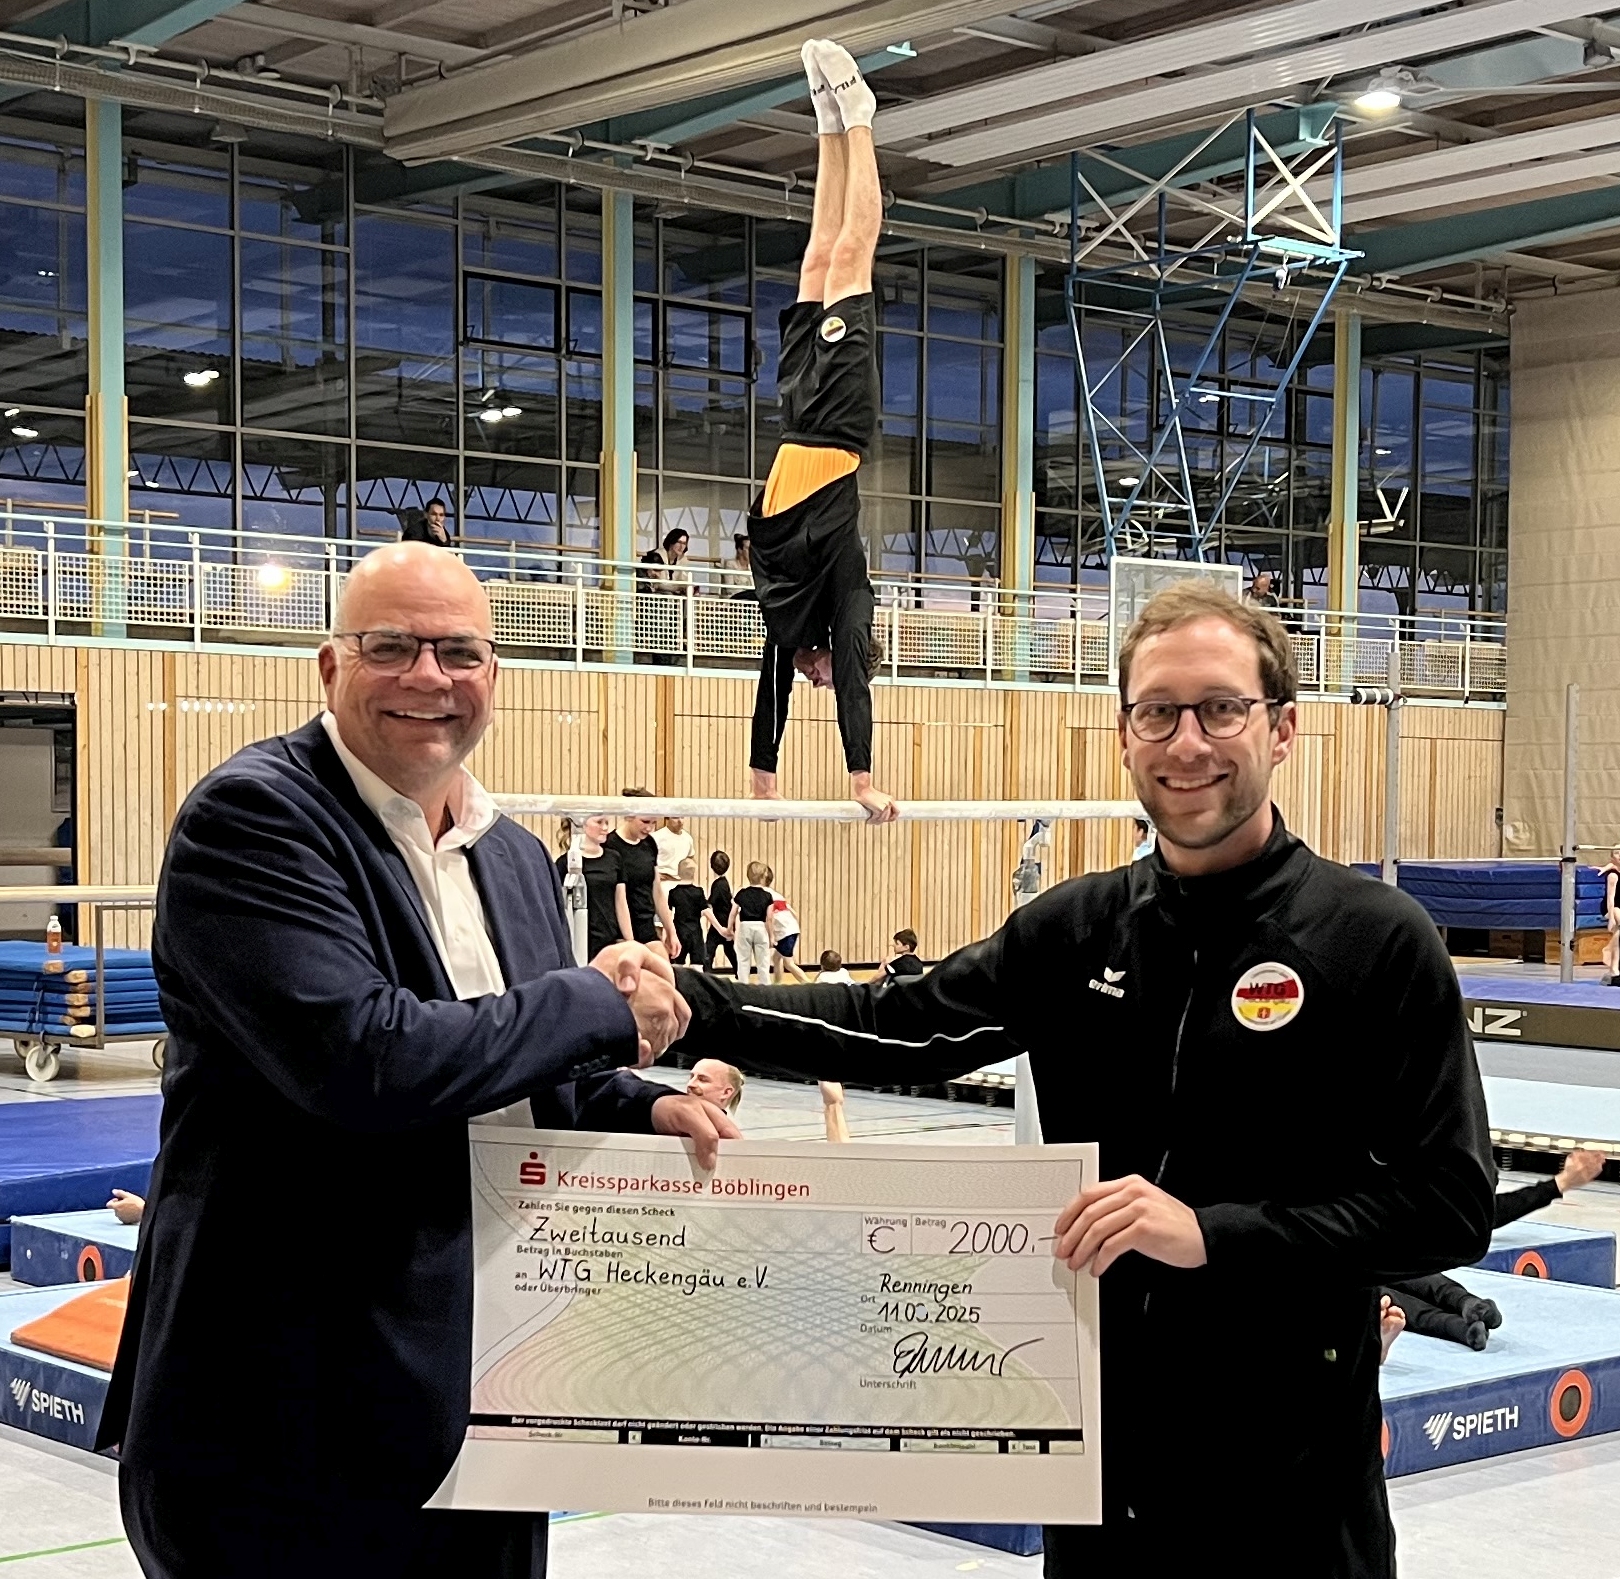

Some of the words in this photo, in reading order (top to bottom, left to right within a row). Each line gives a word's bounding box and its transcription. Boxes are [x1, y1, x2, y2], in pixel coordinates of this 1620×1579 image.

[1249, 981, 1286, 996] WTG
[558, 1171, 703, 1194] Kreissparkasse
[711, 1177, 810, 1200] Böblingen
[518, 1201, 552, 1211] Zahlen
[555, 1202, 570, 1211] Sie
[573, 1205, 603, 1216] gegen
[606, 1205, 639, 1215] diesen
[641, 1206, 675, 1217] Scheck
[864, 1216, 907, 1228] Währung
[915, 1217, 947, 1229] Betrag
[529, 1216, 686, 1247] Zweitausend
[867, 1225, 895, 1254] €
[516, 1245, 549, 1257] Betrag
[552, 1246, 562, 1255] in
[565, 1247, 623, 1258] Buchstaben
[539, 1258, 591, 1282] WTG
[606, 1261, 725, 1296] Heckengäu
[737, 1265, 769, 1289] e.V.
[514, 1283, 538, 1292] oder
[540, 1282, 602, 1297] Überbringer
[879, 1273, 973, 1303] Renningen
[860, 1294, 876, 1303] Ort
[860, 1323, 892, 1334] Datum
[860, 1378, 917, 1390] Unterschrift
[31, 1388, 85, 1425] SPIETH
[1452, 1405, 1519, 1441] SPIETH
[648, 1497, 670, 1508] Bitte
[672, 1498, 702, 1509] dieses
[704, 1499, 724, 1509] Feld
[726, 1500, 748, 1510] nicht
[750, 1501, 802, 1511] beschriften
[804, 1502, 822, 1512] und
[824, 1503, 878, 1514] bestempeln
